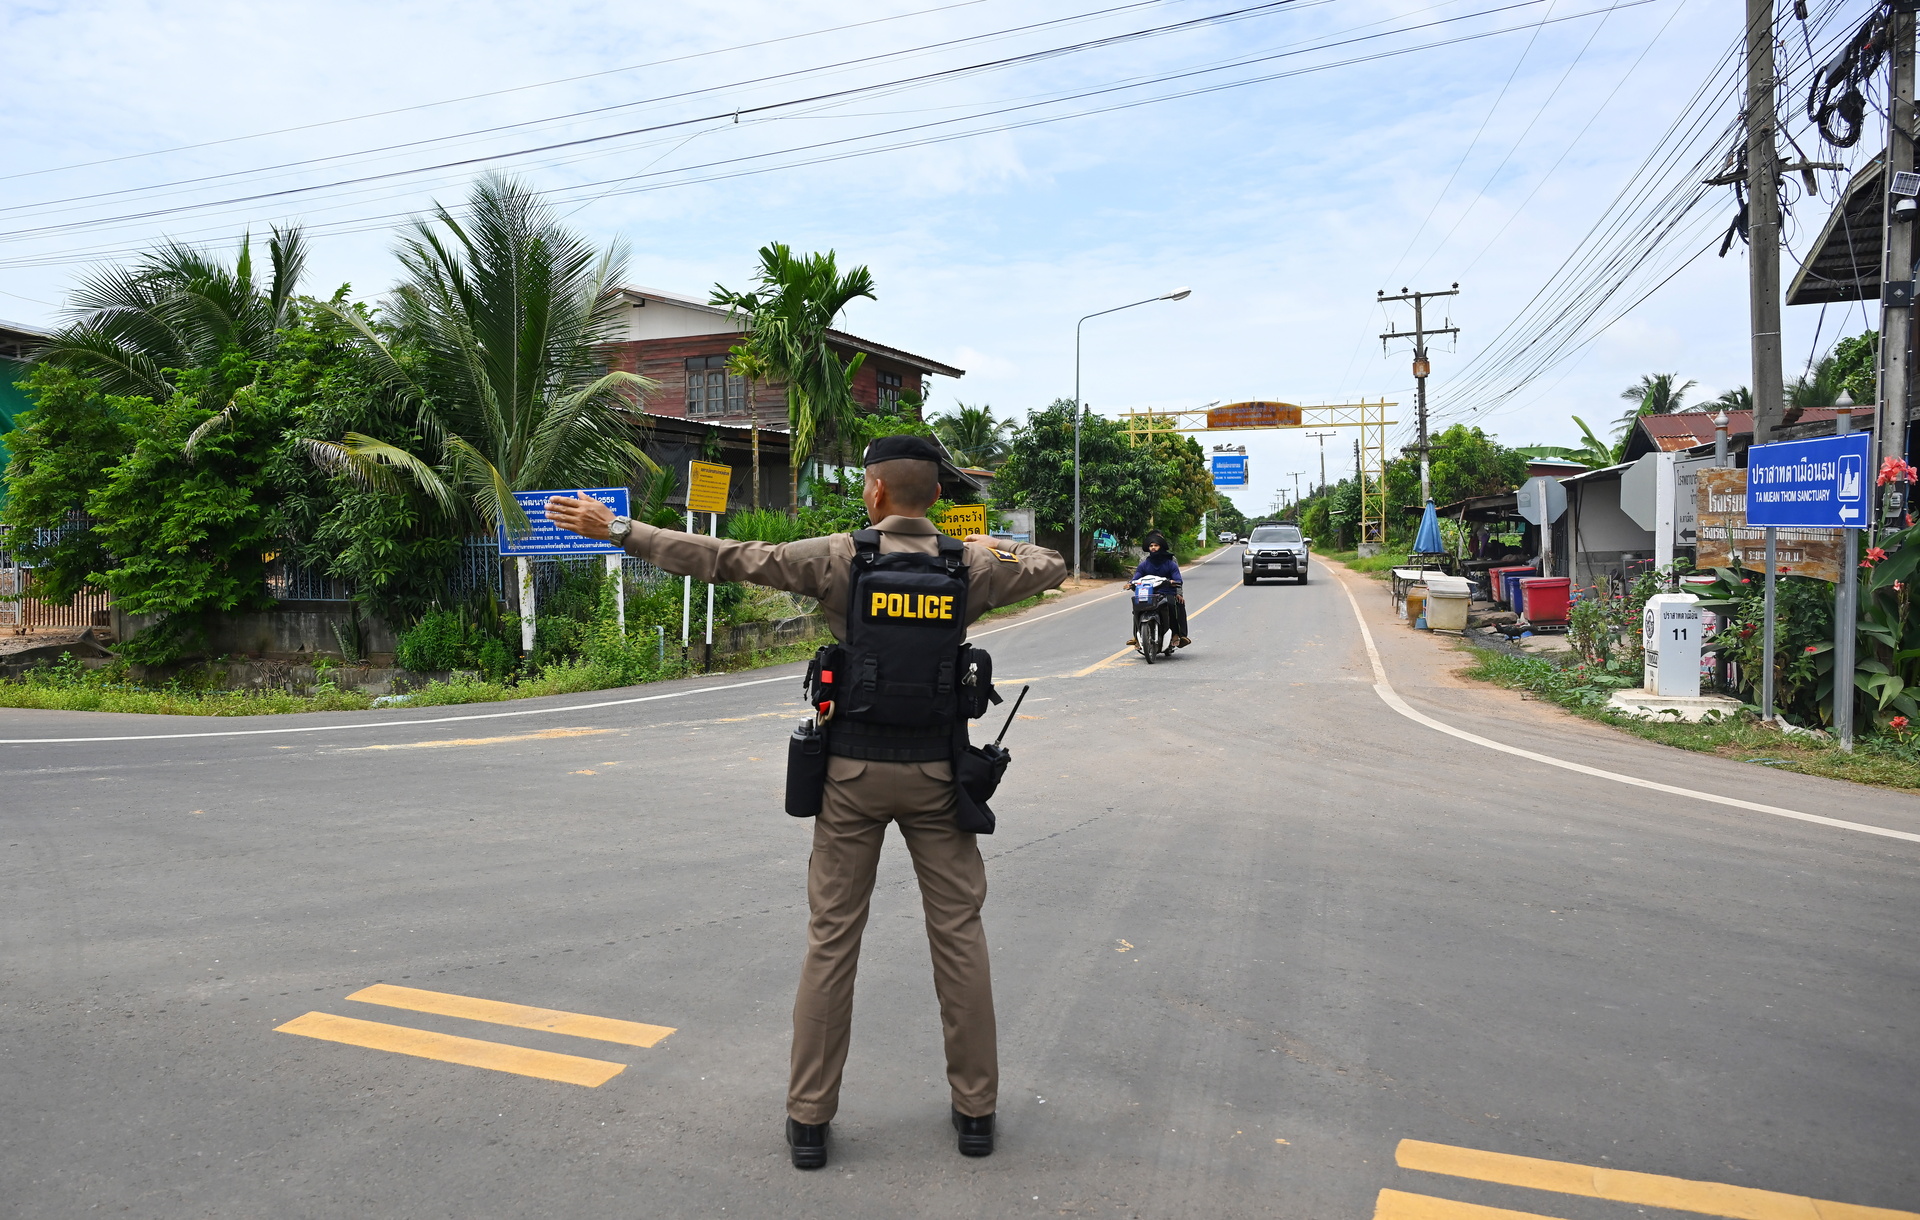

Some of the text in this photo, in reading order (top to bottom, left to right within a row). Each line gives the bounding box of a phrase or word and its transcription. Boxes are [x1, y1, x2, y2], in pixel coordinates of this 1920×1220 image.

[1752, 456, 1835, 484] ปราสาทตาเมือนธม
[1756, 488, 1830, 502] TA MUEAN THOM SANCTUARY
[938, 511, 982, 524] ปรดระวัง
[871, 592, 954, 619] POLICE
[1672, 628, 1687, 641] 11
